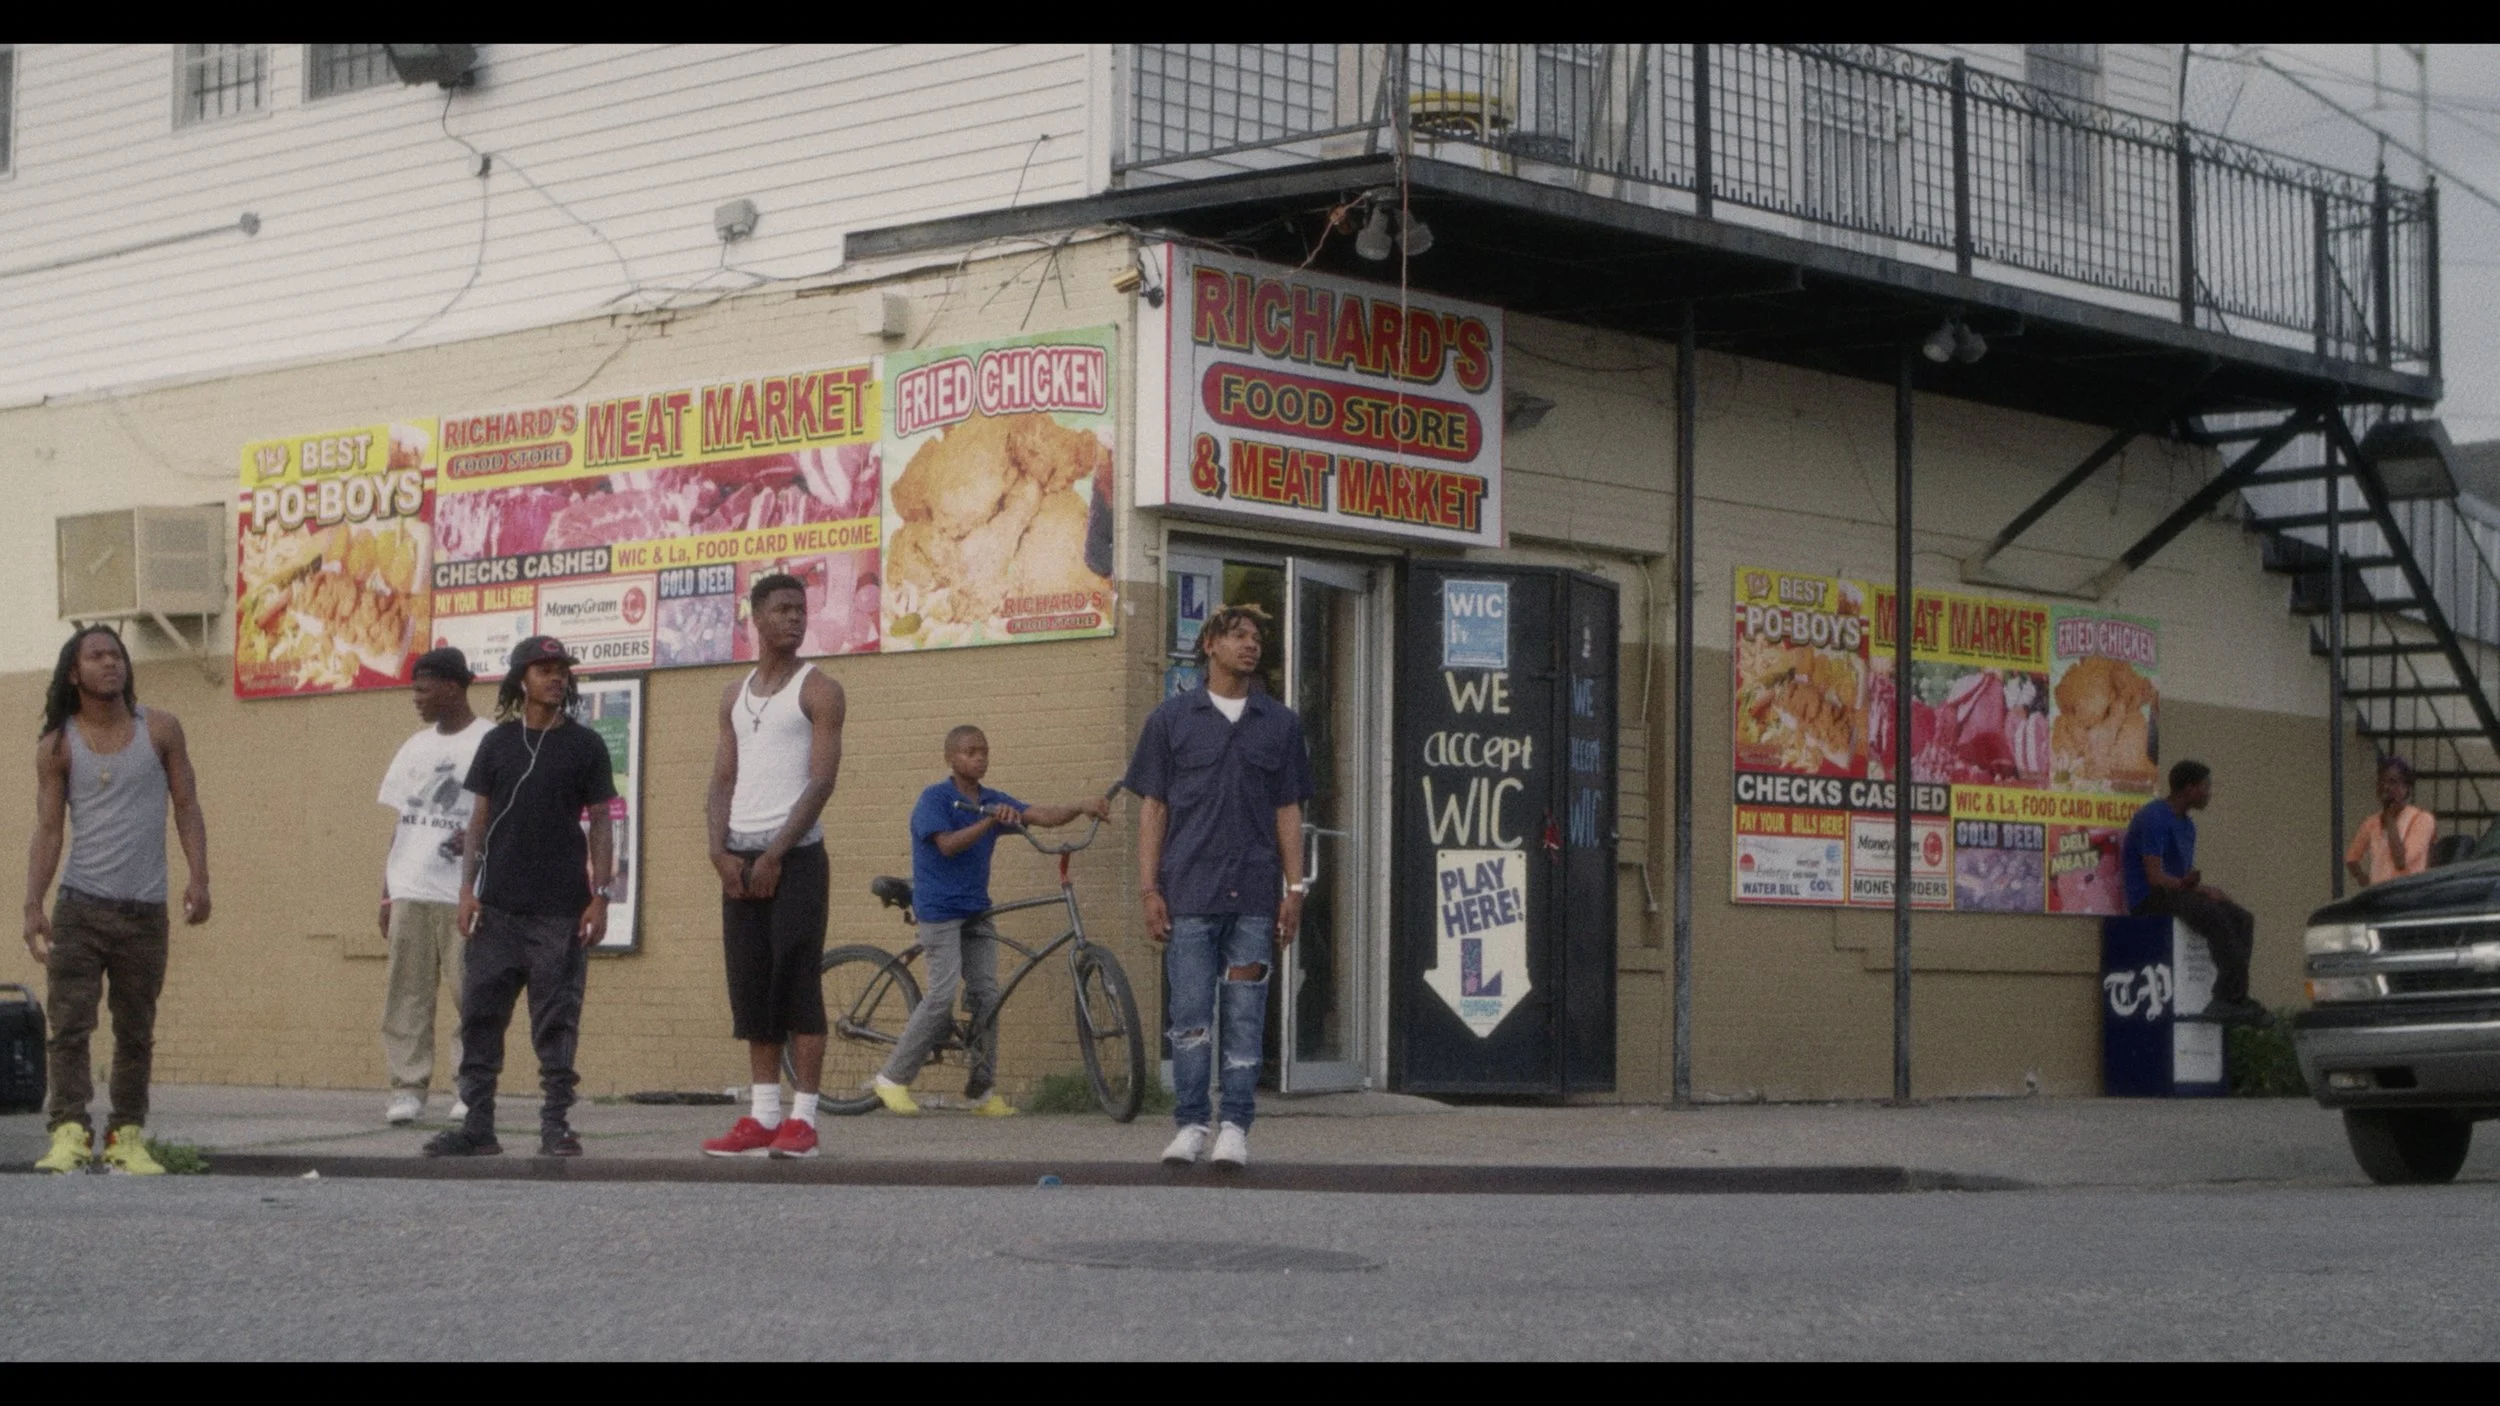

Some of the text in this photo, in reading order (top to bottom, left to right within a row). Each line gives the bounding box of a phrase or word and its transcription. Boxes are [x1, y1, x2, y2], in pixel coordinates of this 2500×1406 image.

[1191, 265, 1493, 394] RICHARD'S
[899, 352, 1103, 432] FRIED CHICKEN
[1220, 374, 1468, 451] FOOD STORE
[444, 404, 578, 451] RICHARD'S
[584, 364, 873, 468] MEAT MARKET
[301, 432, 373, 475] BEST
[454, 447, 564, 475] FOOD STORE
[252, 467, 423, 534] PO-BOYS
[1191, 432, 1487, 533] & MEAT MARKET
[618, 548, 647, 567] WIC
[653, 547, 664, 564] &
[697, 539, 739, 560] FOOD
[744, 533, 787, 555] CARD
[793, 523, 878, 550] WELCOME.
[435, 549, 609, 587] CHECKS CASHED
[660, 570, 694, 598] COLD
[699, 566, 734, 594] BEER
[435, 584, 534, 614] PAY YOUR BILLS HERE
[546, 597, 617, 617] MoneyGram
[1449, 591, 1504, 618] WIC
[1780, 576, 1828, 607] BEST
[1744, 604, 1861, 651] PO-BOYS
[1875, 591, 2046, 663] MAT MARKET
[2058, 621, 2155, 668] FRIED CHICKEN
[592, 640, 650, 659] ORDERS
[1445, 671, 1510, 714] WE
[1424, 731, 1532, 772] accept
[1422, 776, 1523, 849] WIC
[1737, 774, 1947, 812] CHECKS CASED
[1955, 792, 1981, 812] WIC
[1986, 793, 1995, 813] &
[2022, 795, 2057, 817] FOOD
[2060, 799, 2092, 819] CARD
[1739, 811, 1844, 835] PAY YOUR BILLS HERE
[1956, 821, 2043, 850] COLD BEER
[2059, 832, 2090, 850] DELI
[1440, 857, 1506, 901] PLAY
[2051, 850, 2100, 873] MEATS
[1743, 881, 1800, 896] WATER BILL
[1910, 882, 1948, 897] RDERS
[1442, 887, 1524, 938] HERE!
